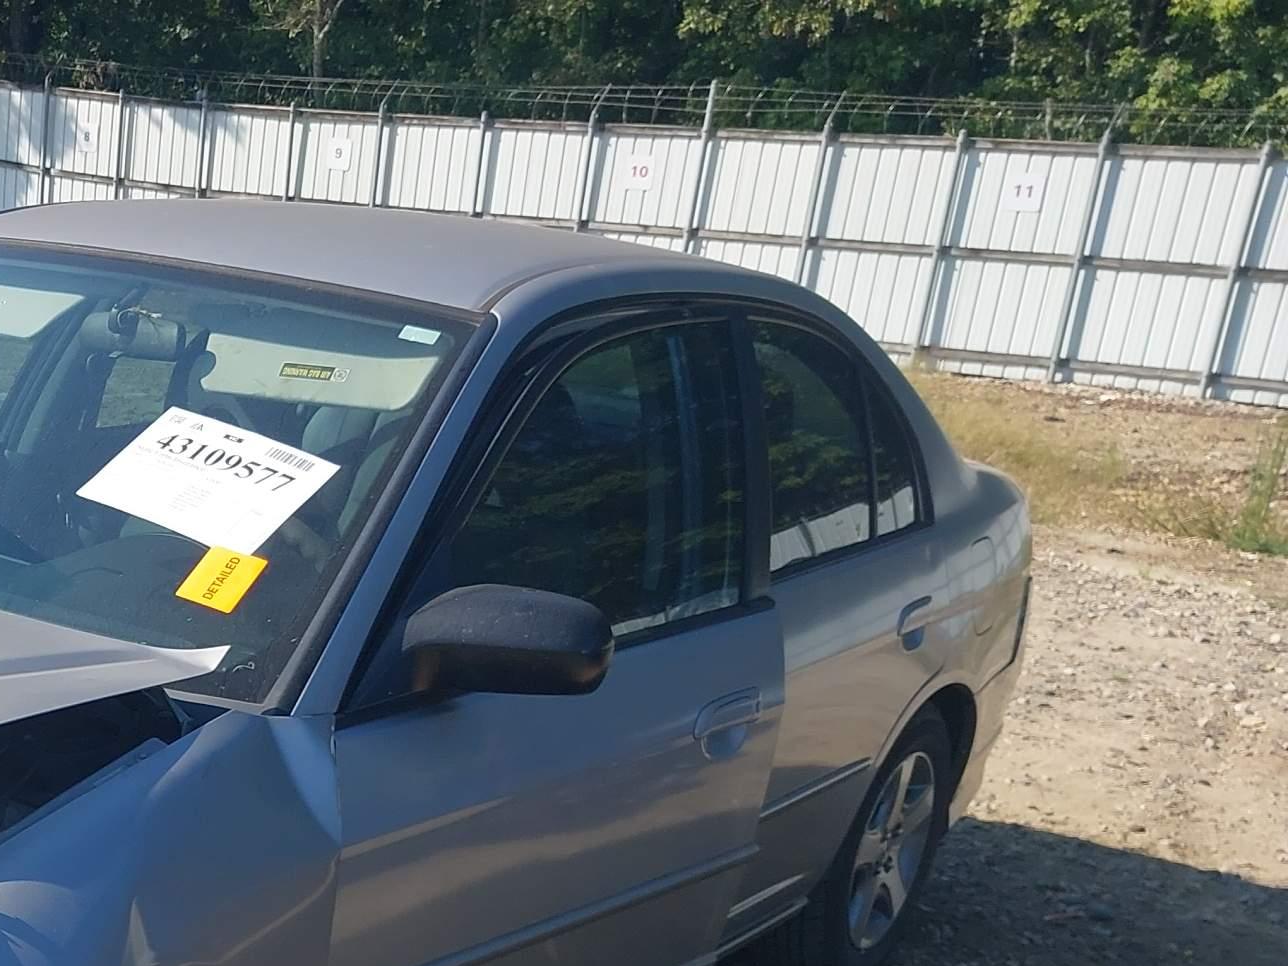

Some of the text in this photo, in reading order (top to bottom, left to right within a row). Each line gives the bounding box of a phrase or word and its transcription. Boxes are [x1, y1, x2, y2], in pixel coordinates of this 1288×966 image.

[334, 147, 343, 158] 9
[630, 165, 649, 179] 10
[1014, 183, 1034, 198] 11
[157, 434, 296, 491] 43109577
[203, 557, 241, 600] DETAILED
